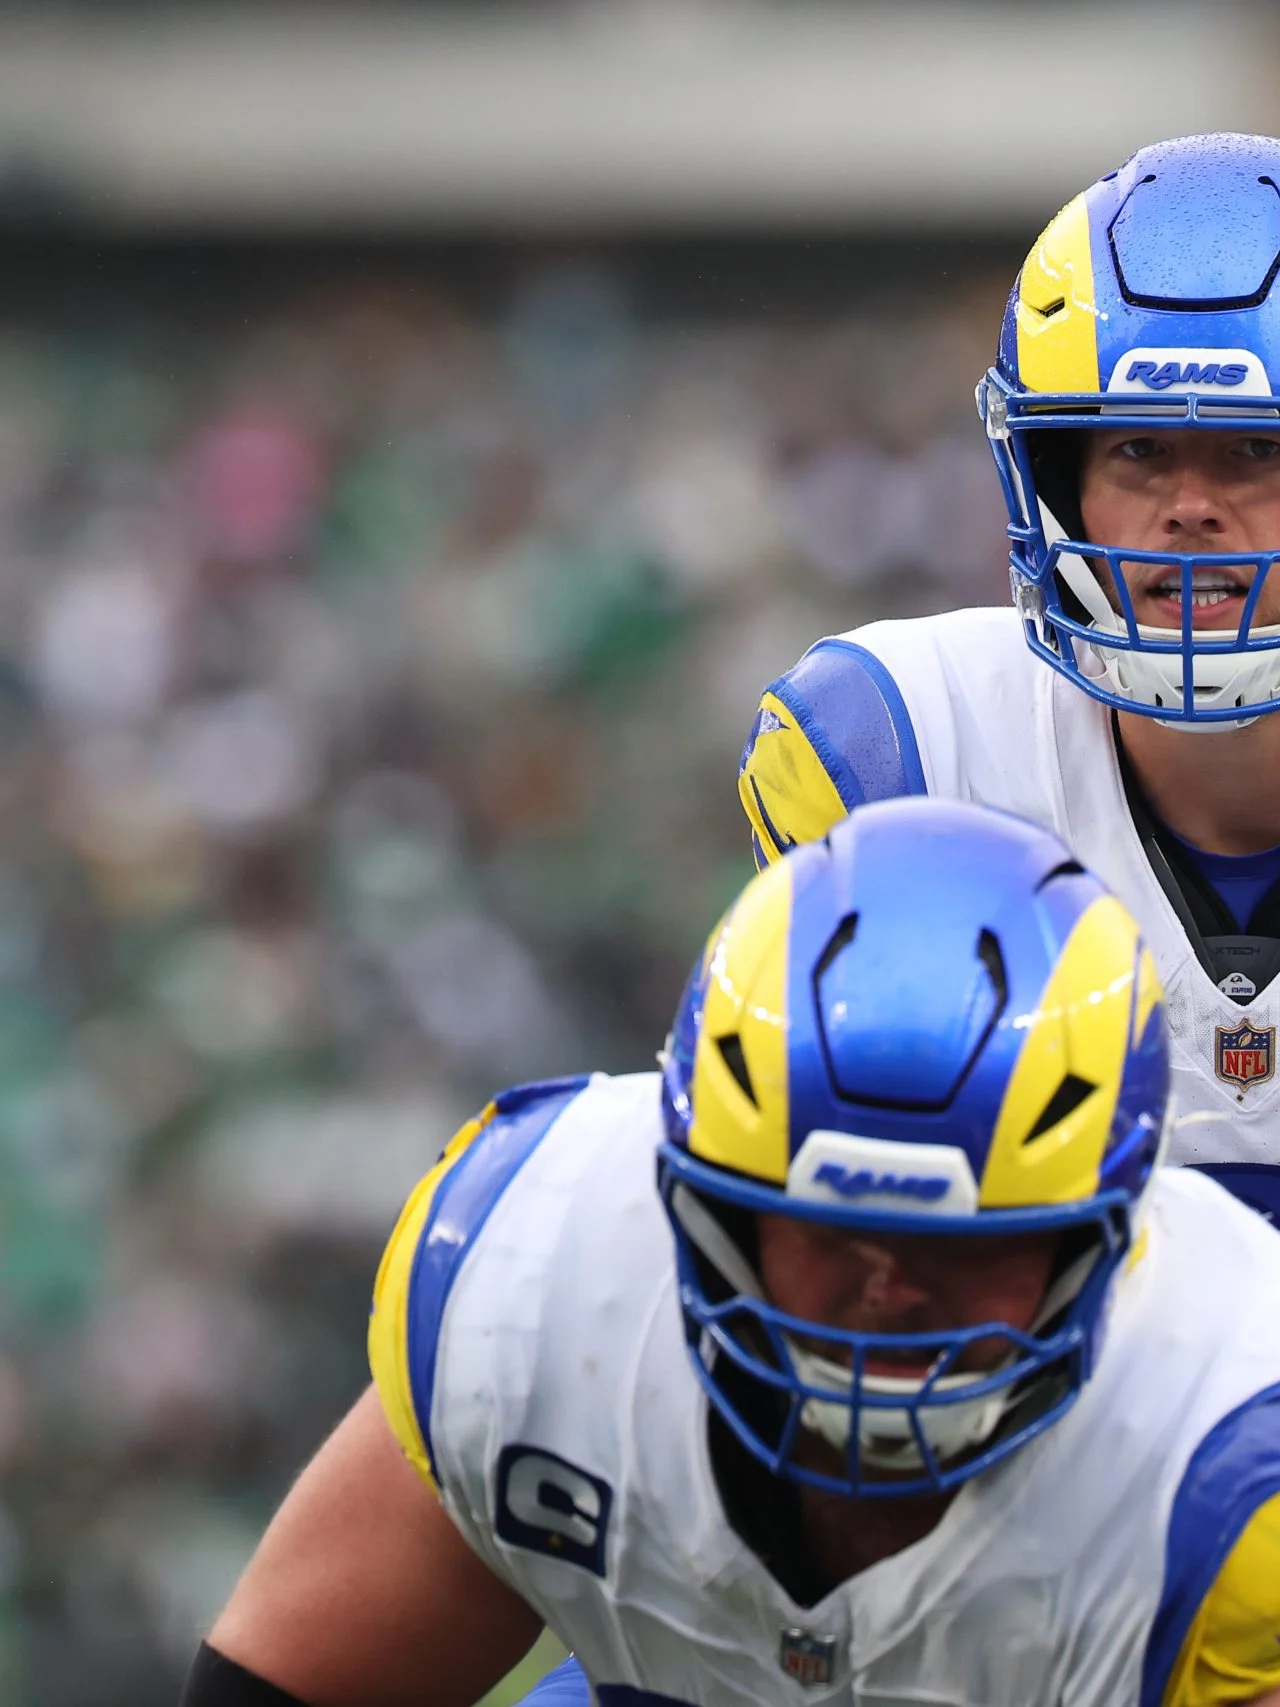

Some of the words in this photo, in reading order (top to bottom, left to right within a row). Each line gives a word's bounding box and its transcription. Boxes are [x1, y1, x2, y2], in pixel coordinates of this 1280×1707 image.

[1125, 361, 1249, 390] RAMS
[1224, 1050, 1266, 1079] NFL
[813, 1163, 952, 1203] RAMS
[505, 1455, 600, 1548] C
